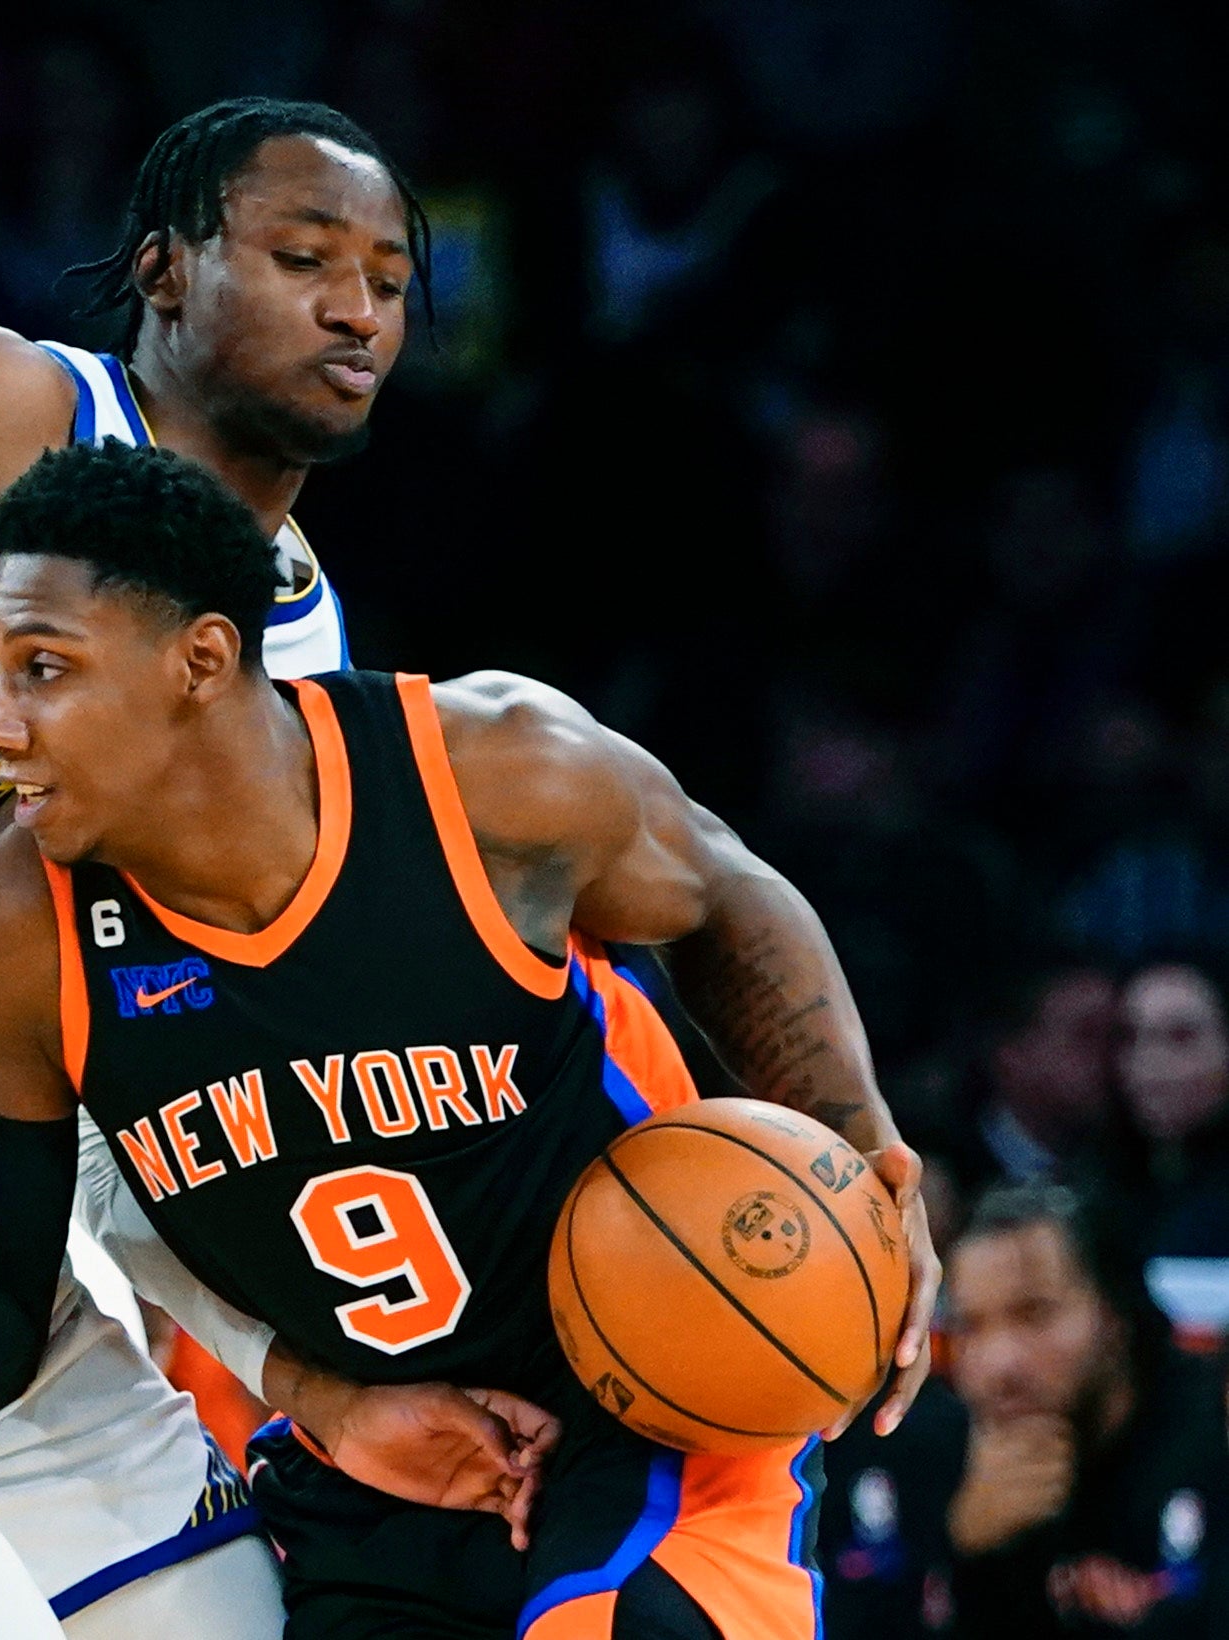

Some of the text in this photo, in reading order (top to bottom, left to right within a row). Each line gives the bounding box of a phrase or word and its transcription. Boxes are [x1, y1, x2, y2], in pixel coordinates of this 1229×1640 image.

[90, 899, 126, 948] 6
[109, 956, 214, 1018] NYC
[116, 1044, 527, 1203] NEW YORK
[289, 1164, 472, 1356] 9
